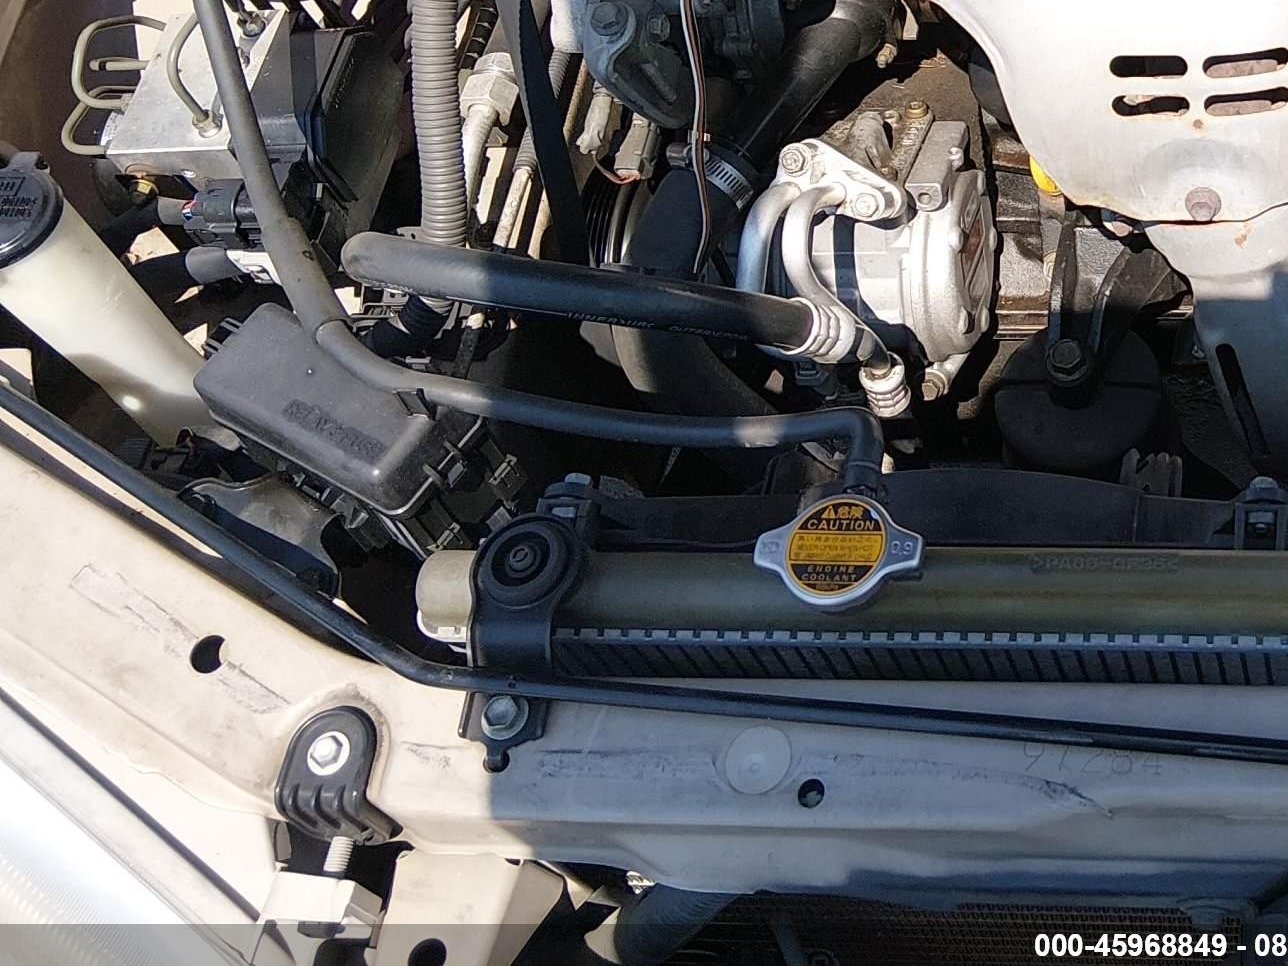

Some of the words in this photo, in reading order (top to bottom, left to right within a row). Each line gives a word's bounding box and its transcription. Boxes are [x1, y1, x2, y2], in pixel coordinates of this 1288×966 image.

[807, 519, 875, 531] CAUTION
[890, 540, 913, 556] 0.9
[807, 565, 855, 574] ENGINE
[801, 573, 857, 582] COOLANT
